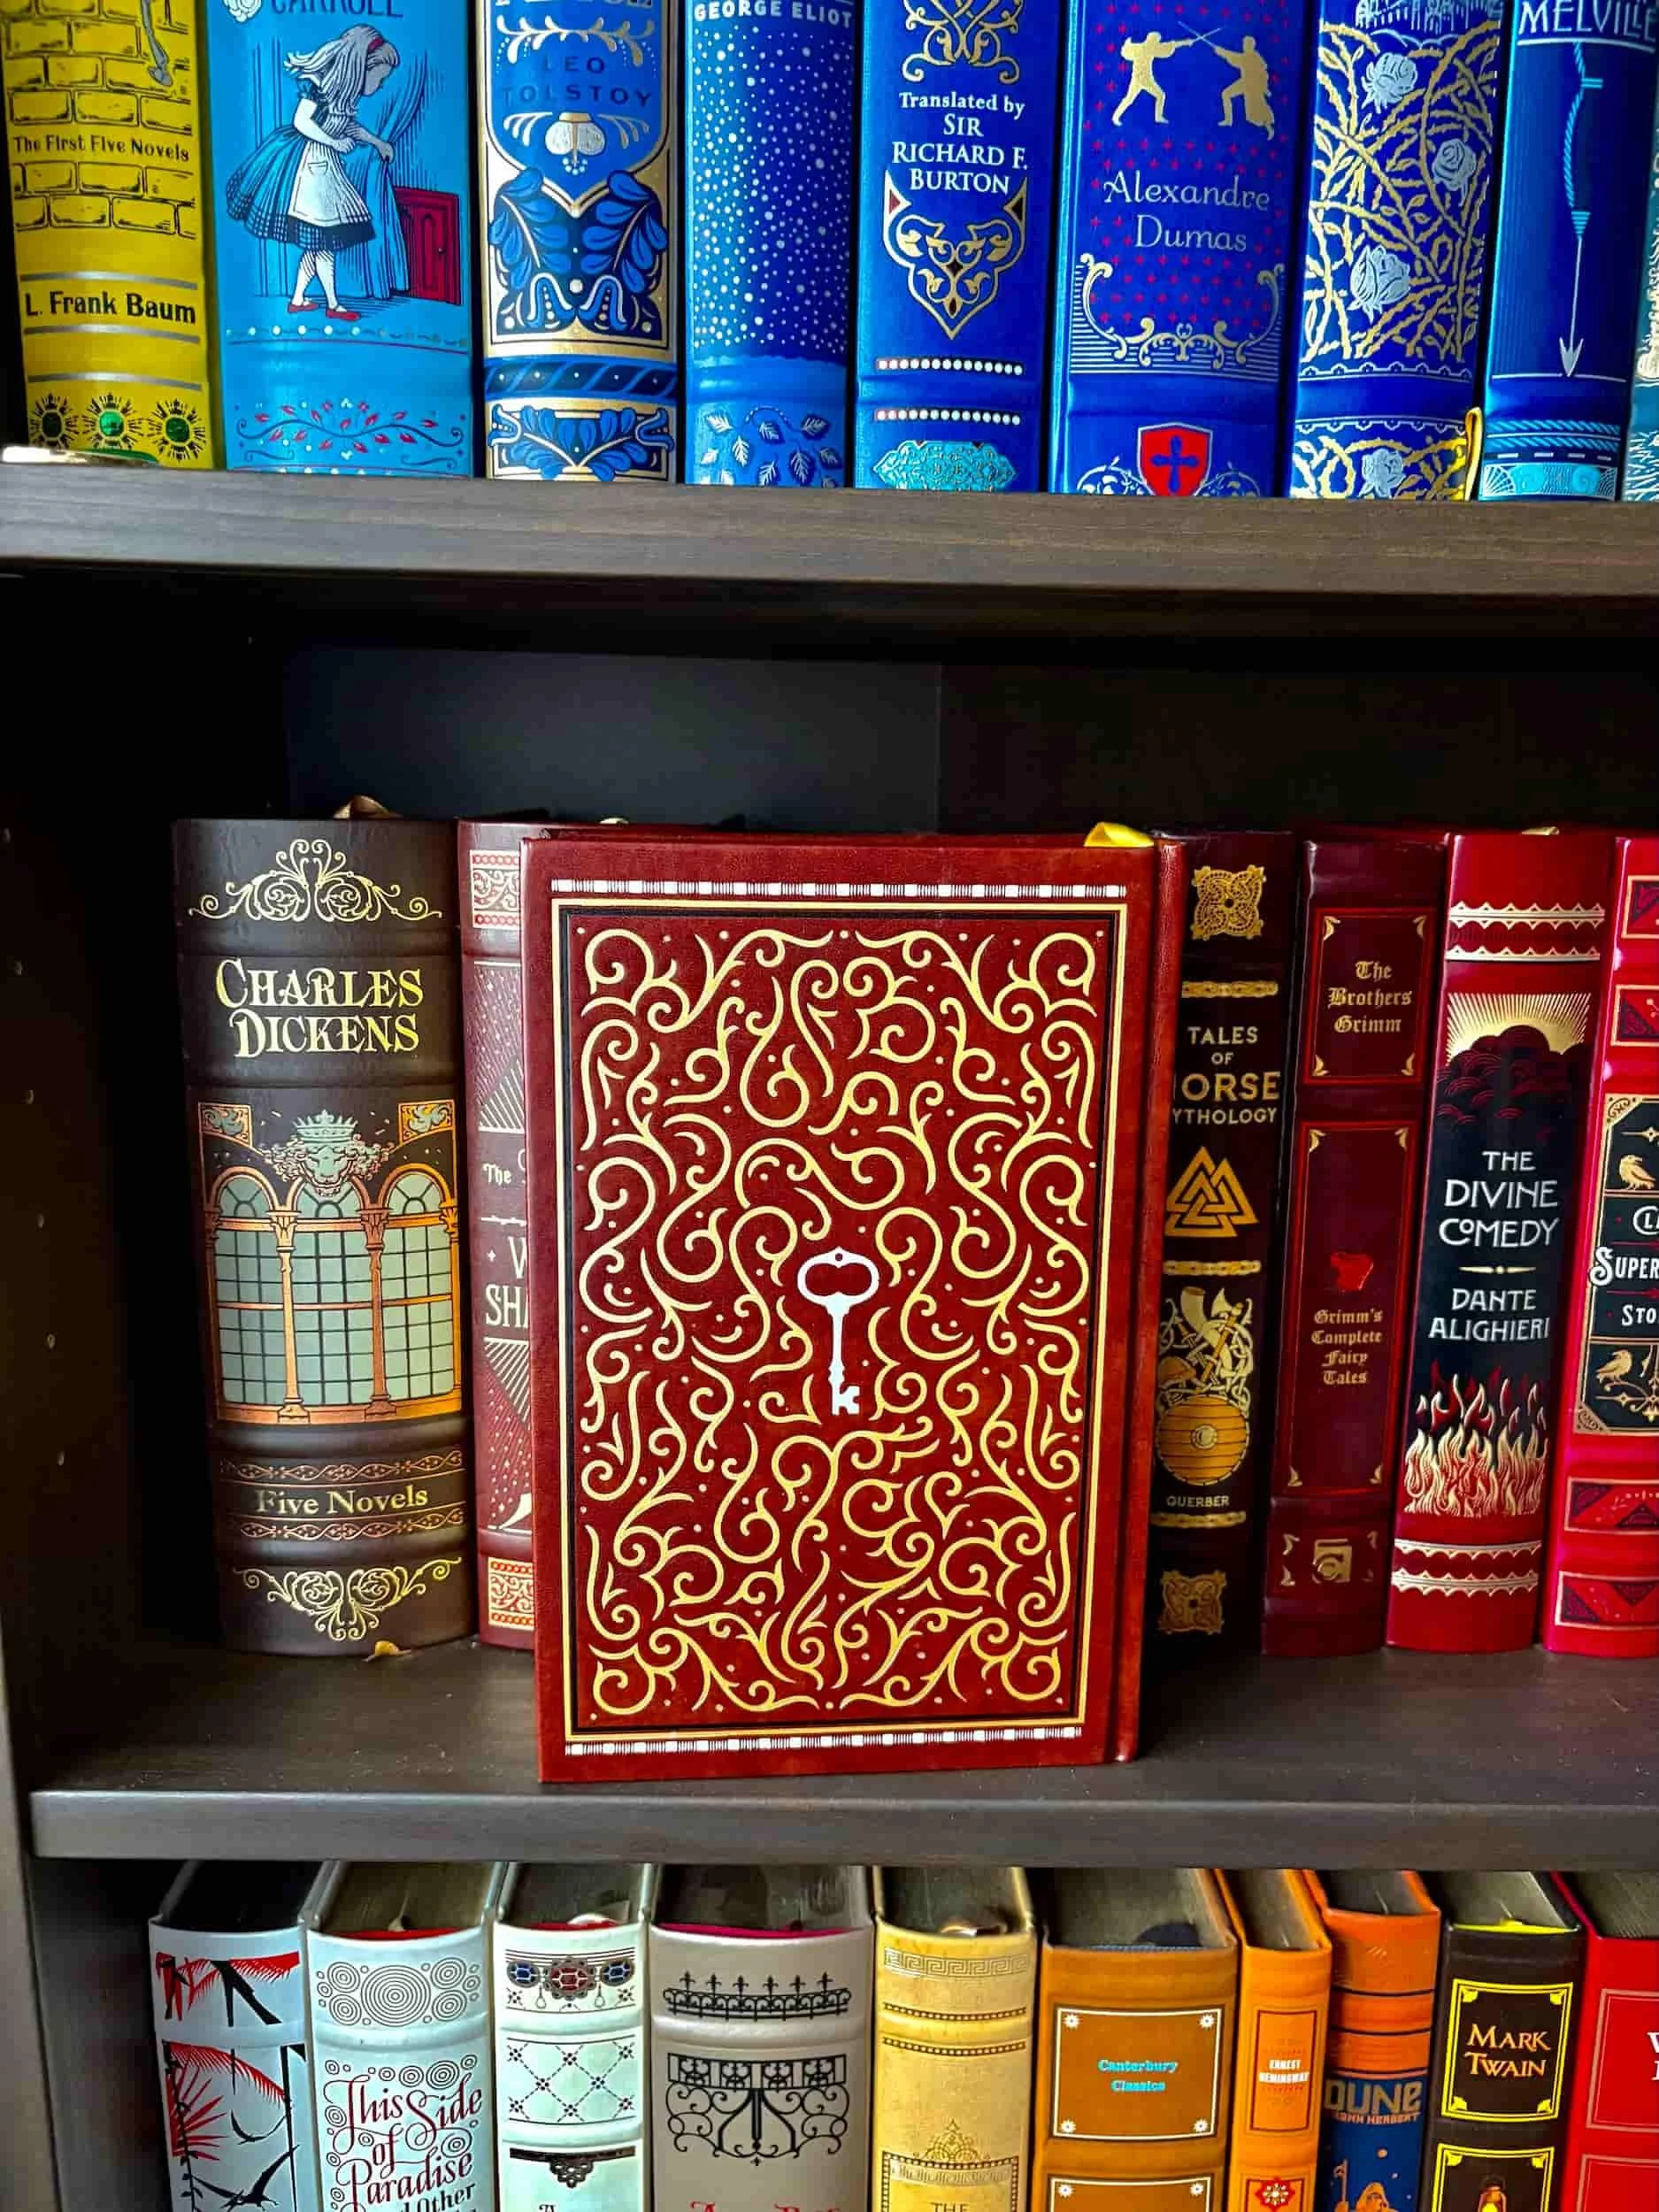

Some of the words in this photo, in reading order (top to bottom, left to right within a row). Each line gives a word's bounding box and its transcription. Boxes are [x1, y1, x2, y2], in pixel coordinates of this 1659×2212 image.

[694, 0, 782, 21] GEORGE
[792, 2, 852, 28] ELIOT
[1518, 0, 1657, 42] MELVILLE
[542, 55, 605, 74] LEO
[502, 84, 653, 107] TOLSTOY
[899, 91, 998, 111] Translated
[1003, 96, 1025, 119] by
[943, 113, 984, 136] SIR
[13, 136, 40, 153] The
[46, 134, 85, 152] First
[91, 134, 126, 152] Five
[132, 139, 189, 162] Novels
[892, 142, 1005, 165] RICHARD
[1012, 147, 1028, 170] F.
[910, 168, 1009, 196] BURTON
[1103, 169, 1270, 211] Alexandre
[1134, 213, 1247, 252] Dumas
[25, 293, 42, 317] L.
[50, 291, 117, 315] Frank
[126, 293, 196, 324] Baum
[216, 957, 423, 1009] CHARLES
[1355, 961, 1392, 983] The
[1327, 987, 1412, 1009] Brothers
[229, 1008, 419, 1058] DICKENS
[1187, 1025, 1258, 1045] TALES
[1334, 1015, 1402, 1033] Grimm
[1210, 1051, 1233, 1065] OF
[1173, 1071, 1280, 1102] ORSE
[1172, 1107, 1277, 1125] YTHOLOGY
[482, 1162, 511, 1186] The
[1482, 1151, 1536, 1171] THE
[1444, 1179, 1558, 1209] DIVINE
[1439, 1217, 1560, 1248] COMEDY
[1451, 1287, 1537, 1311] DANTE
[1314, 1308, 1383, 1325] Grimm's
[1428, 1316, 1550, 1341] ALIGHIERI
[1622, 1304, 1659, 1326] STO
[1310, 1330, 1382, 1346] Complete
[1322, 1350, 1368, 1367] Fairy
[1323, 1370, 1368, 1386] Tales
[255, 1488, 319, 1515] Five
[326, 1484, 428, 1515] Novels
[1466, 2023, 1551, 2052] MARK
[1463, 2051, 1547, 2079] TWAIN
[1325, 2079, 1423, 2115] DUNE
[323, 2074, 403, 2154] This
[405, 2072, 482, 2152] Side
[372, 2124, 404, 2179] of
[335, 2147, 473, 2212] Paradise
